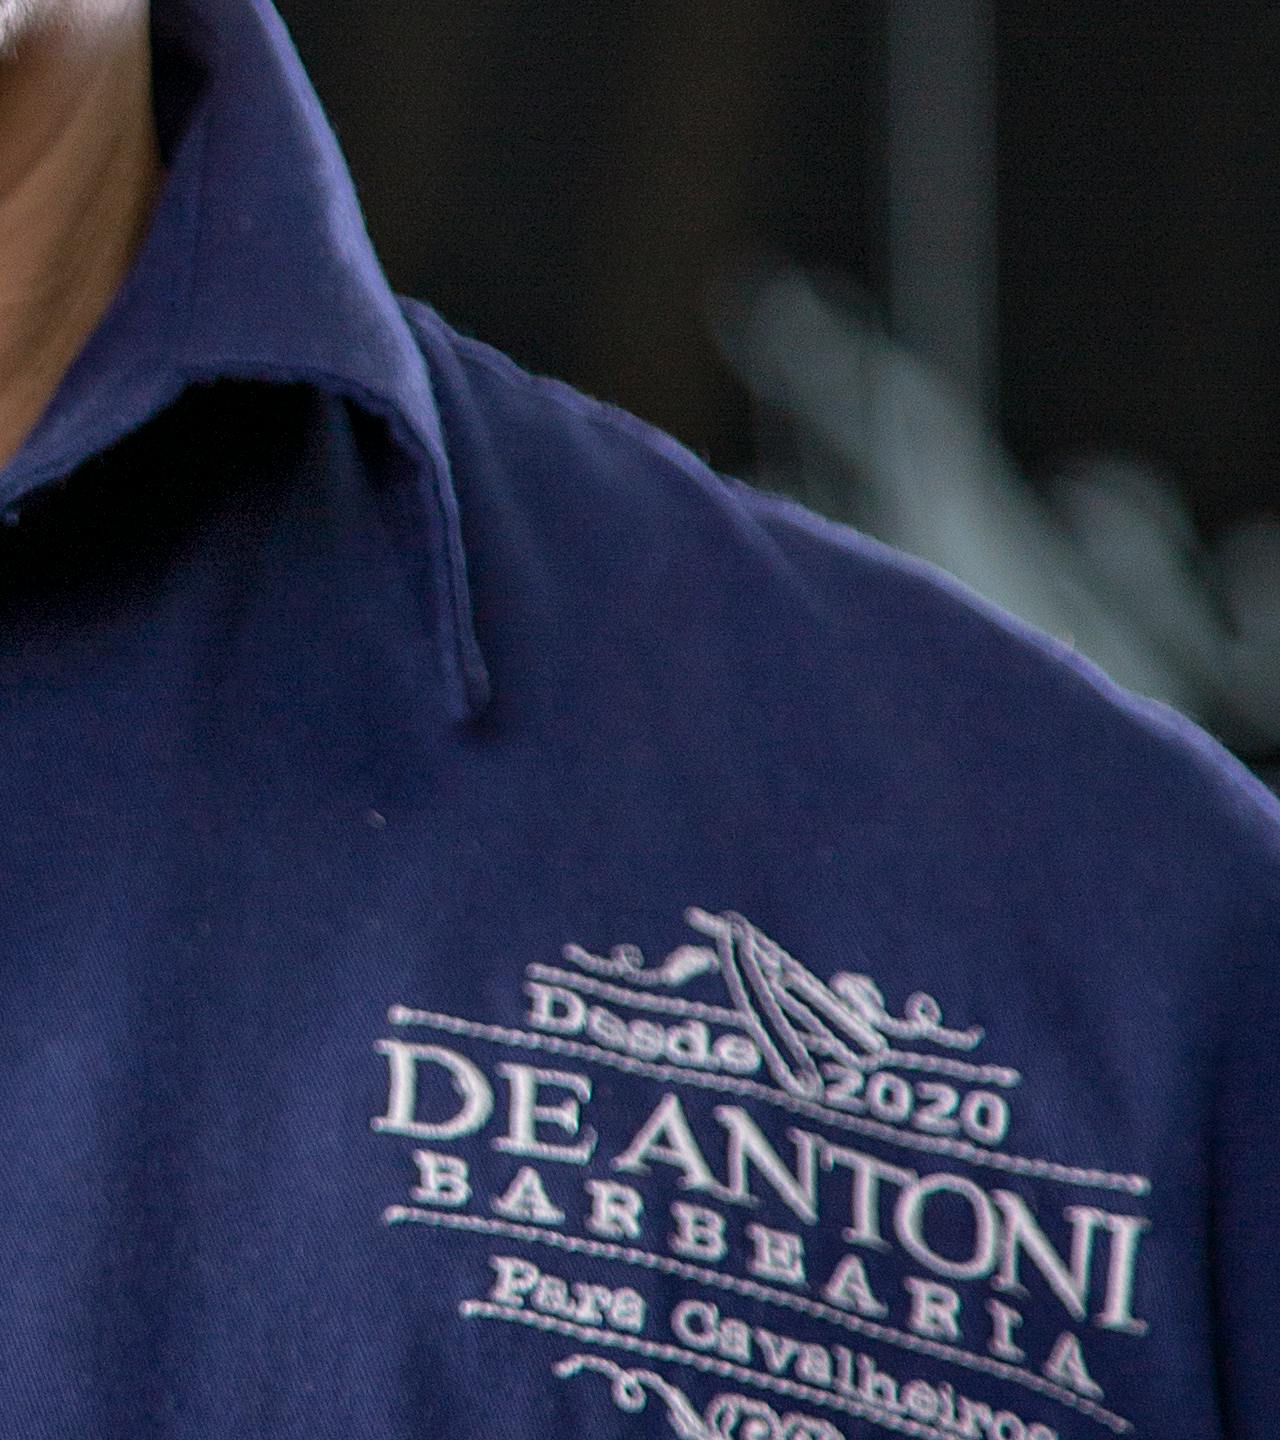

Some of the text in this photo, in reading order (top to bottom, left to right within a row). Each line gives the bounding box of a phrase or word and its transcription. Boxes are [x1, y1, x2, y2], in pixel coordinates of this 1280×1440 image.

[525, 983, 1010, 1146] Desde 2020
[371, 1038, 1151, 1335] DE ANTONI
[411, 1148, 1104, 1399] BARBEARIA
[490, 1255, 647, 1333] Para
